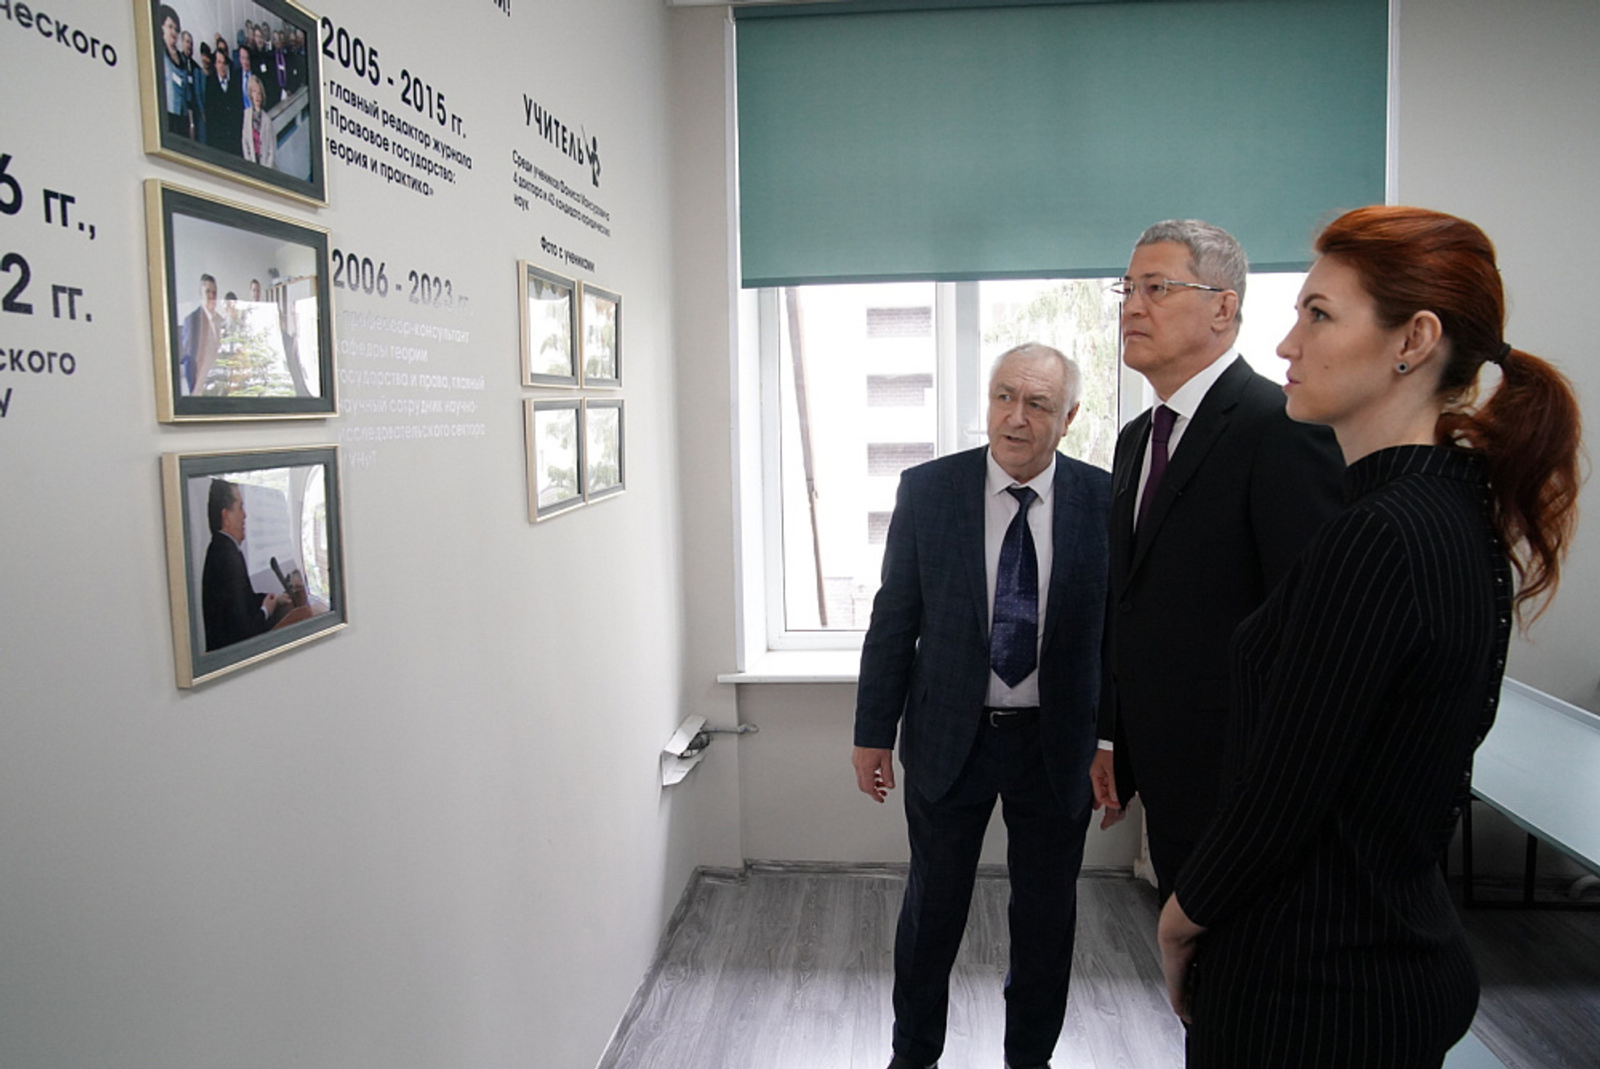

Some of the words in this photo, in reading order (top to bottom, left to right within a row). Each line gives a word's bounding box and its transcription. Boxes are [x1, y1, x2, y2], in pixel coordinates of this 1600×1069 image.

[321, 16, 381, 86] 2005
[387, 76, 394, 86] -
[400, 69, 448, 127] 2015
[451, 113, 467, 139] гг.
[329, 80, 380, 120] главный
[382, 109, 432, 149] редактор
[432, 137, 473, 170] журнала
[523, 93, 585, 166] УЧИТЕЛЬ
[370, 156, 379, 175] и
[380, 162, 434, 196] практика»
[391, 142, 457, 185] государство:
[512, 149, 533, 172] Среди
[42, 188, 96, 241] гг.,
[513, 194, 530, 211] наук
[332, 248, 389, 299] 2006
[395, 282, 402, 292] -
[408, 269, 453, 313] 2023
[540, 235, 559, 257] Фото
[559, 246, 564, 260] с
[564, 249, 596, 273] учениками
[0, 252, 33, 316] 2
[51, 284, 93, 323] гг.
